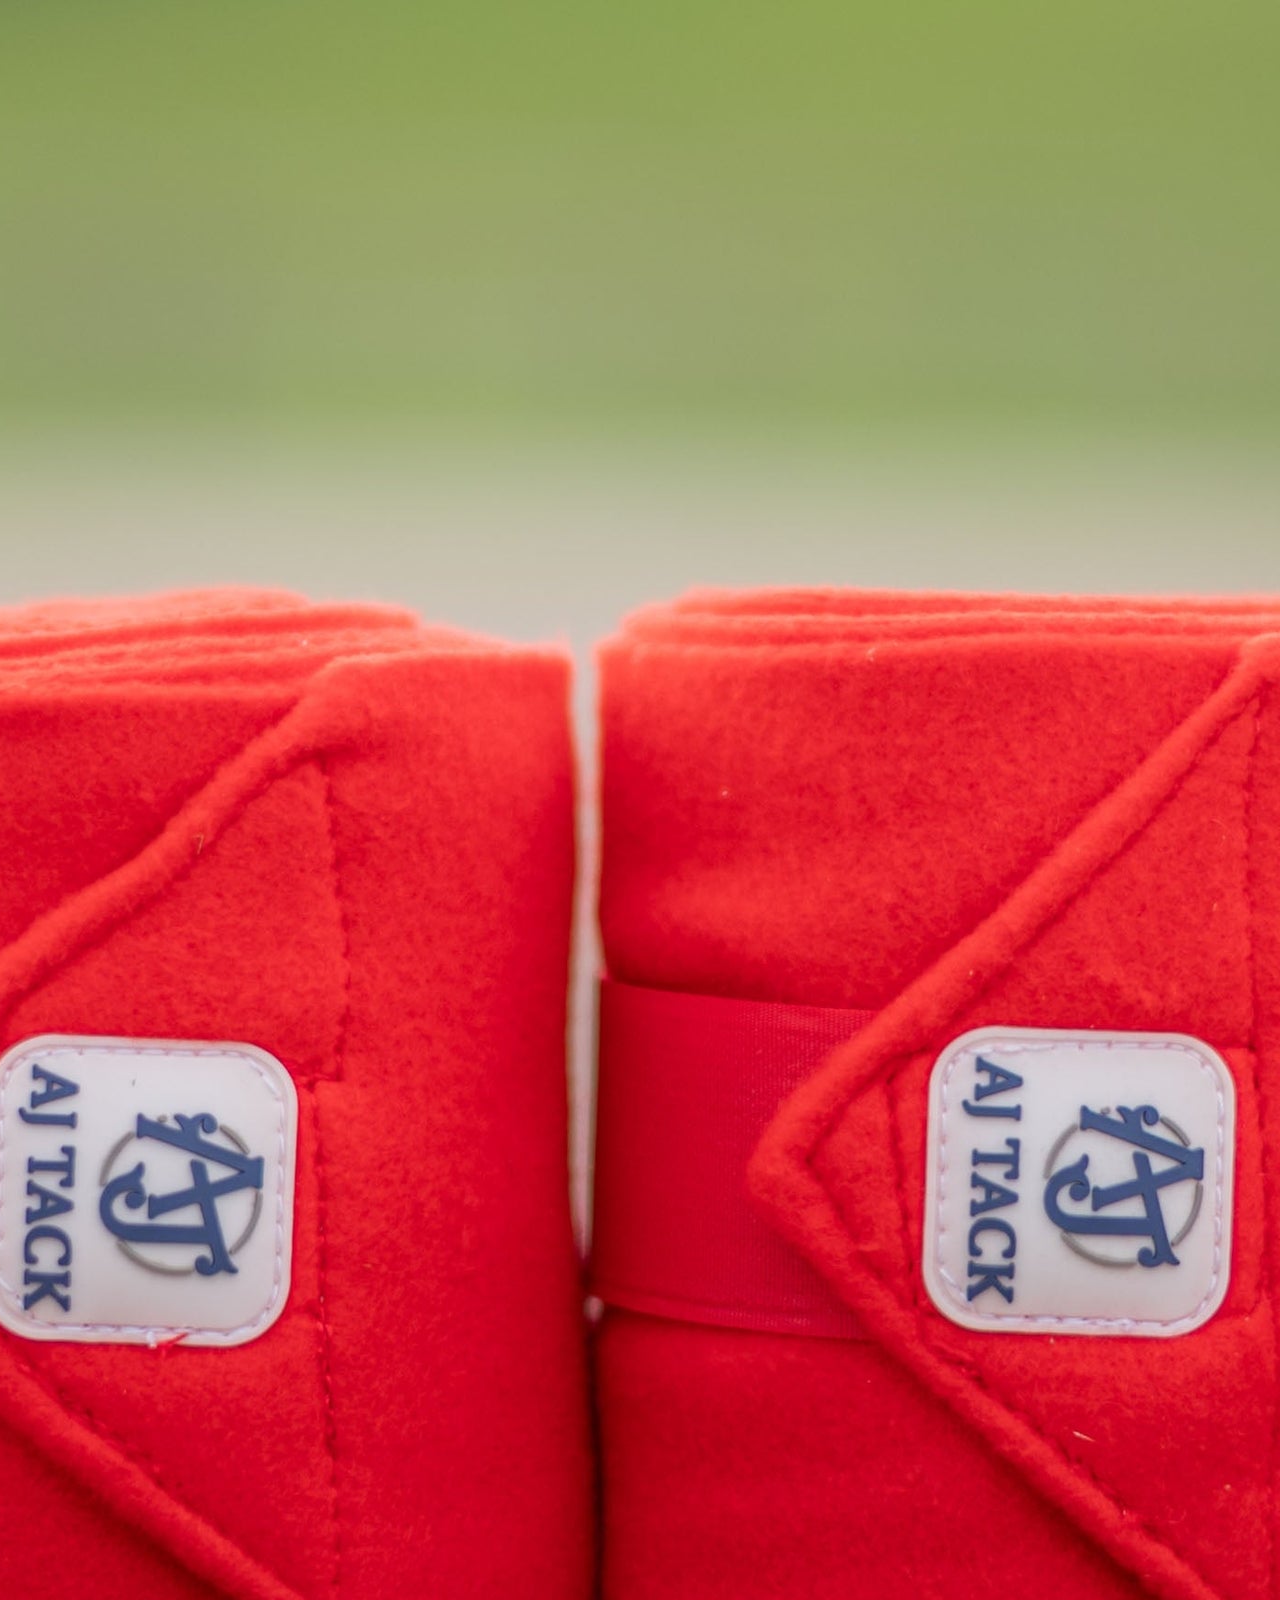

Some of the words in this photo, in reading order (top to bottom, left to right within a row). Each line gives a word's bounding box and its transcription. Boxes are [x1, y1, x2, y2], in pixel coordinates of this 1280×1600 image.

[17, 1064, 79, 1129] AJ
[961, 1056, 1024, 1121] AJ
[22, 1145, 76, 1312] TACK
[966, 1137, 1021, 1303] TACK
